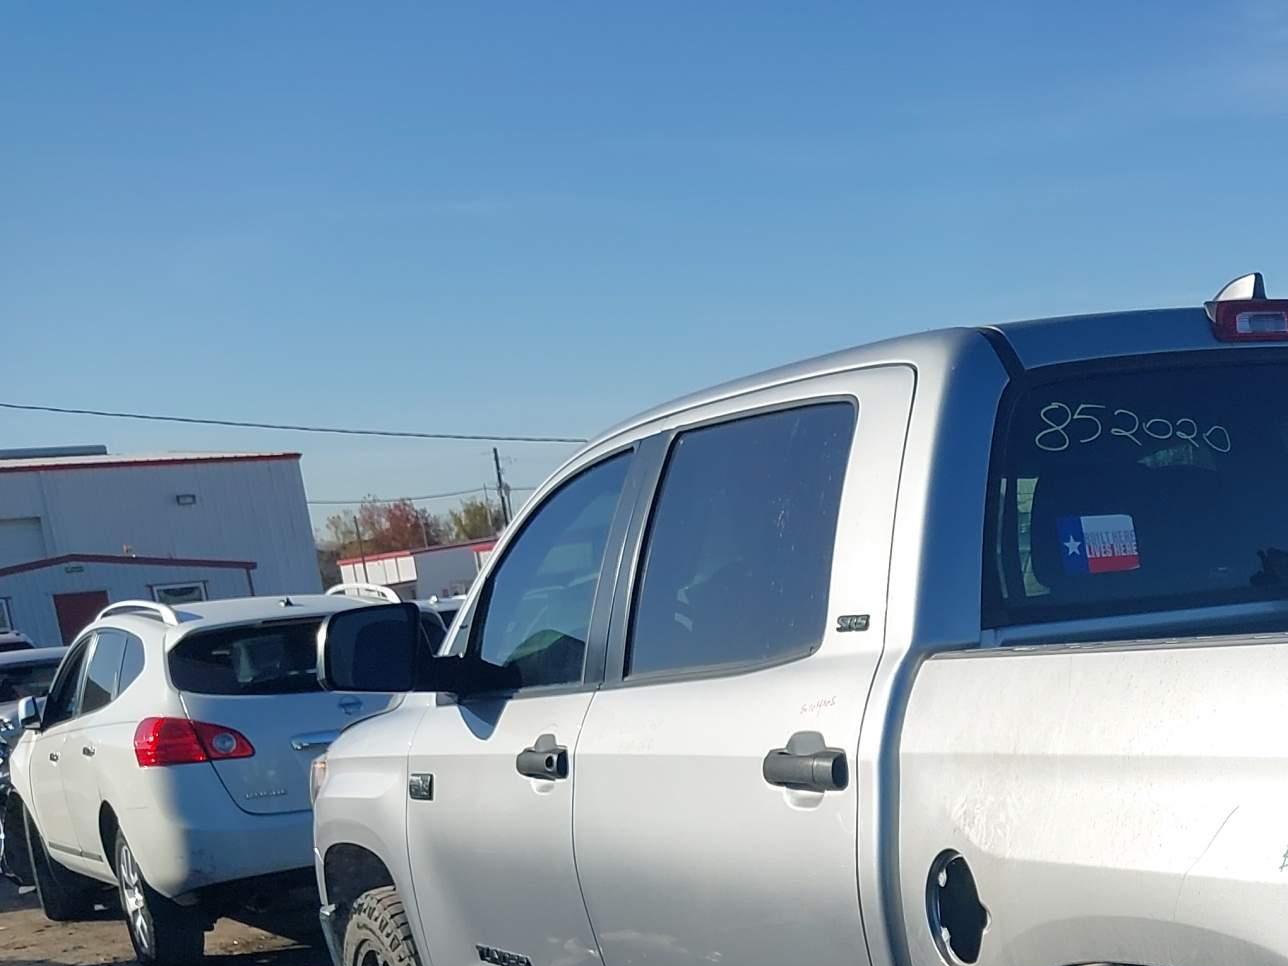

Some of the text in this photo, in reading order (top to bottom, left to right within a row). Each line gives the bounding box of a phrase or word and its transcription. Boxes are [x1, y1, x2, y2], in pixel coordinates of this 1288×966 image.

[1034, 402, 1232, 453] 852020
[1088, 543, 1139, 558] LIVES HERE
